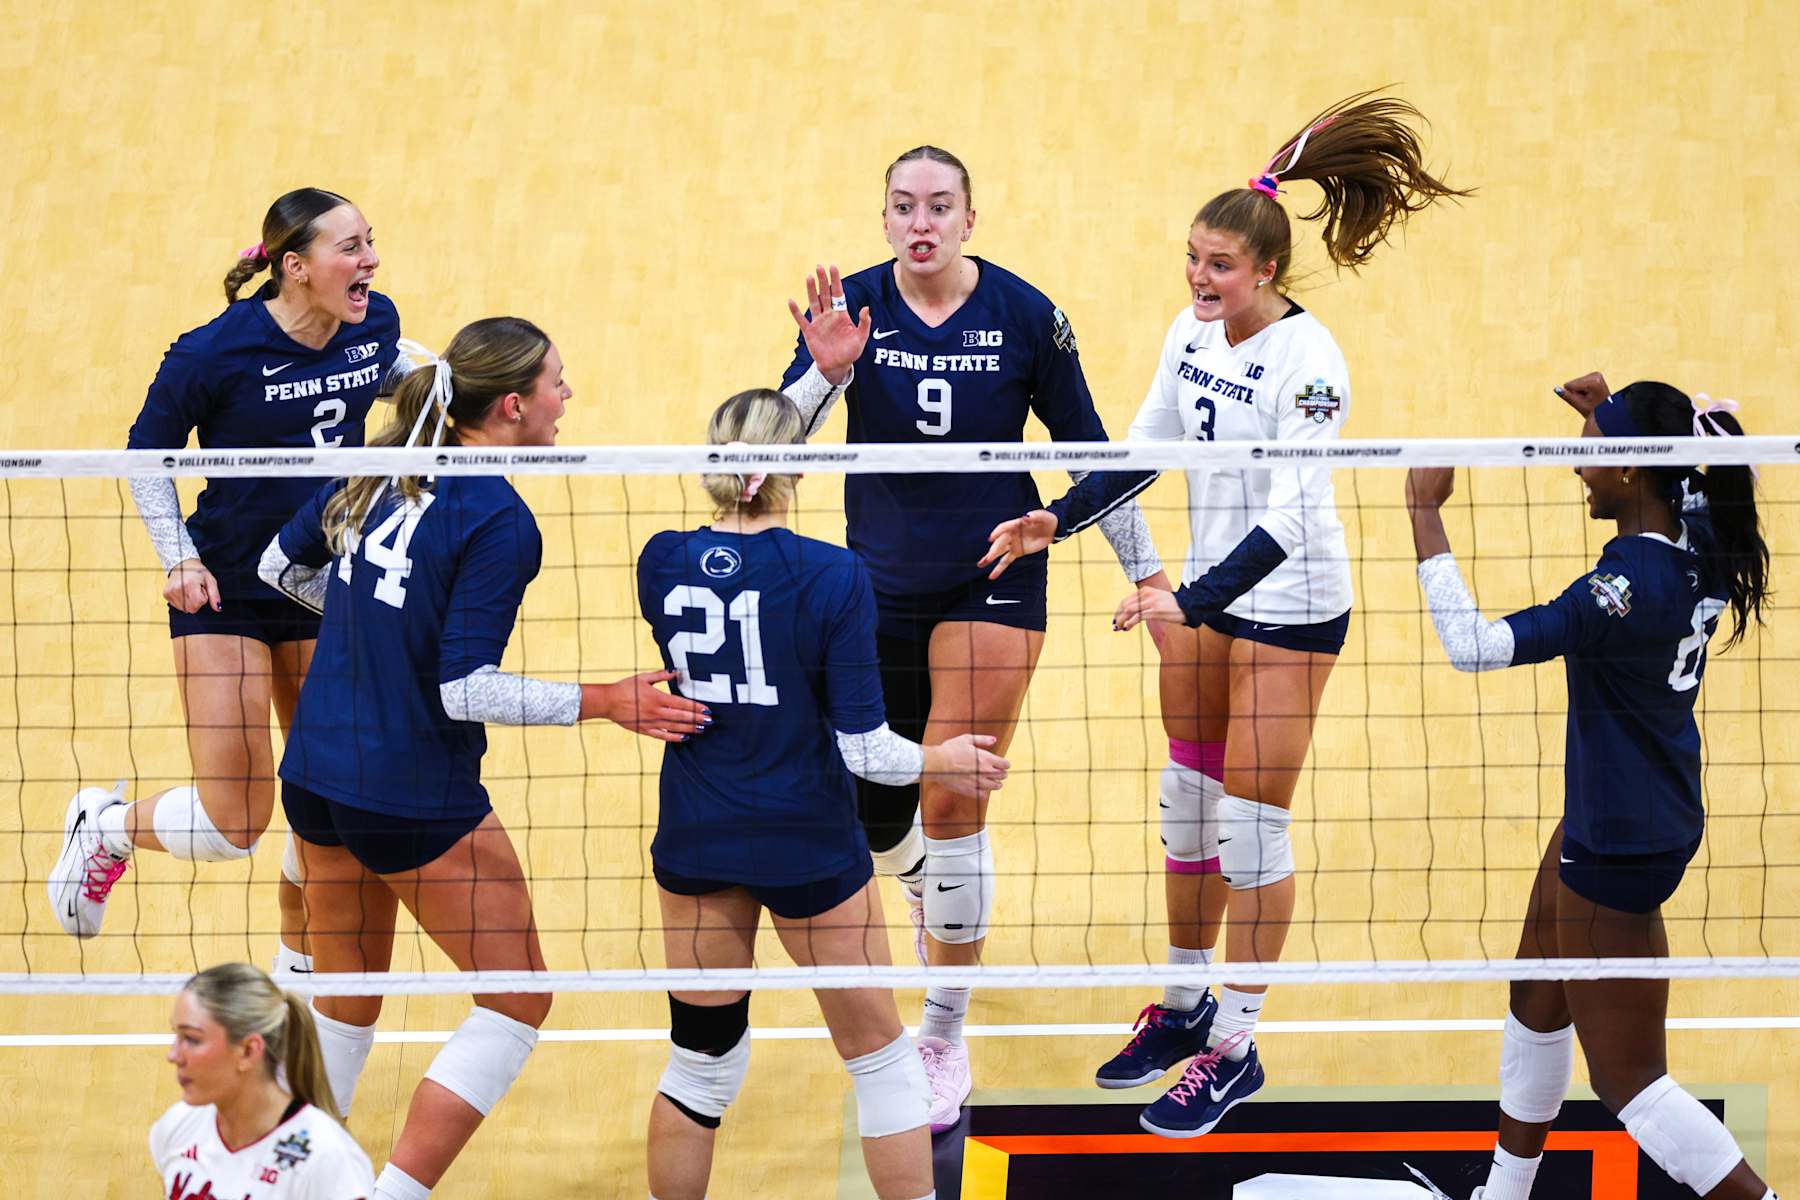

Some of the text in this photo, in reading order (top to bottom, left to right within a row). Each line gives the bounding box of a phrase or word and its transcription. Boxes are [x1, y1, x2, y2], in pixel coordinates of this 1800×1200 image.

[874, 347, 1000, 371] PENN STATE
[265, 363, 379, 402] PENN STATE
[1178, 361, 1254, 405] PENN STATE
[916, 378, 952, 436] 9
[311, 398, 347, 448] 2
[1195, 396, 1216, 441] 3
[723, 452, 858, 463] VOLLEYBALL CHAMPIONSHIP
[994, 450, 1130, 461] VOLLEYBALL CHAMPIONSHIP
[1267, 447, 1402, 458] VOLLEYBALL CHAMPIONSHIP
[1538, 444, 1674, 456] VOLLEYBALL CHAMPIONSHIP
[0, 459, 42, 467] IONSHIP
[178, 456, 315, 467] VOLLEYBALL CHAMPIONSHIP
[451, 454, 587, 465] VOLLEYBALL CHAMPIONSHIP
[664, 585, 779, 706] 21
